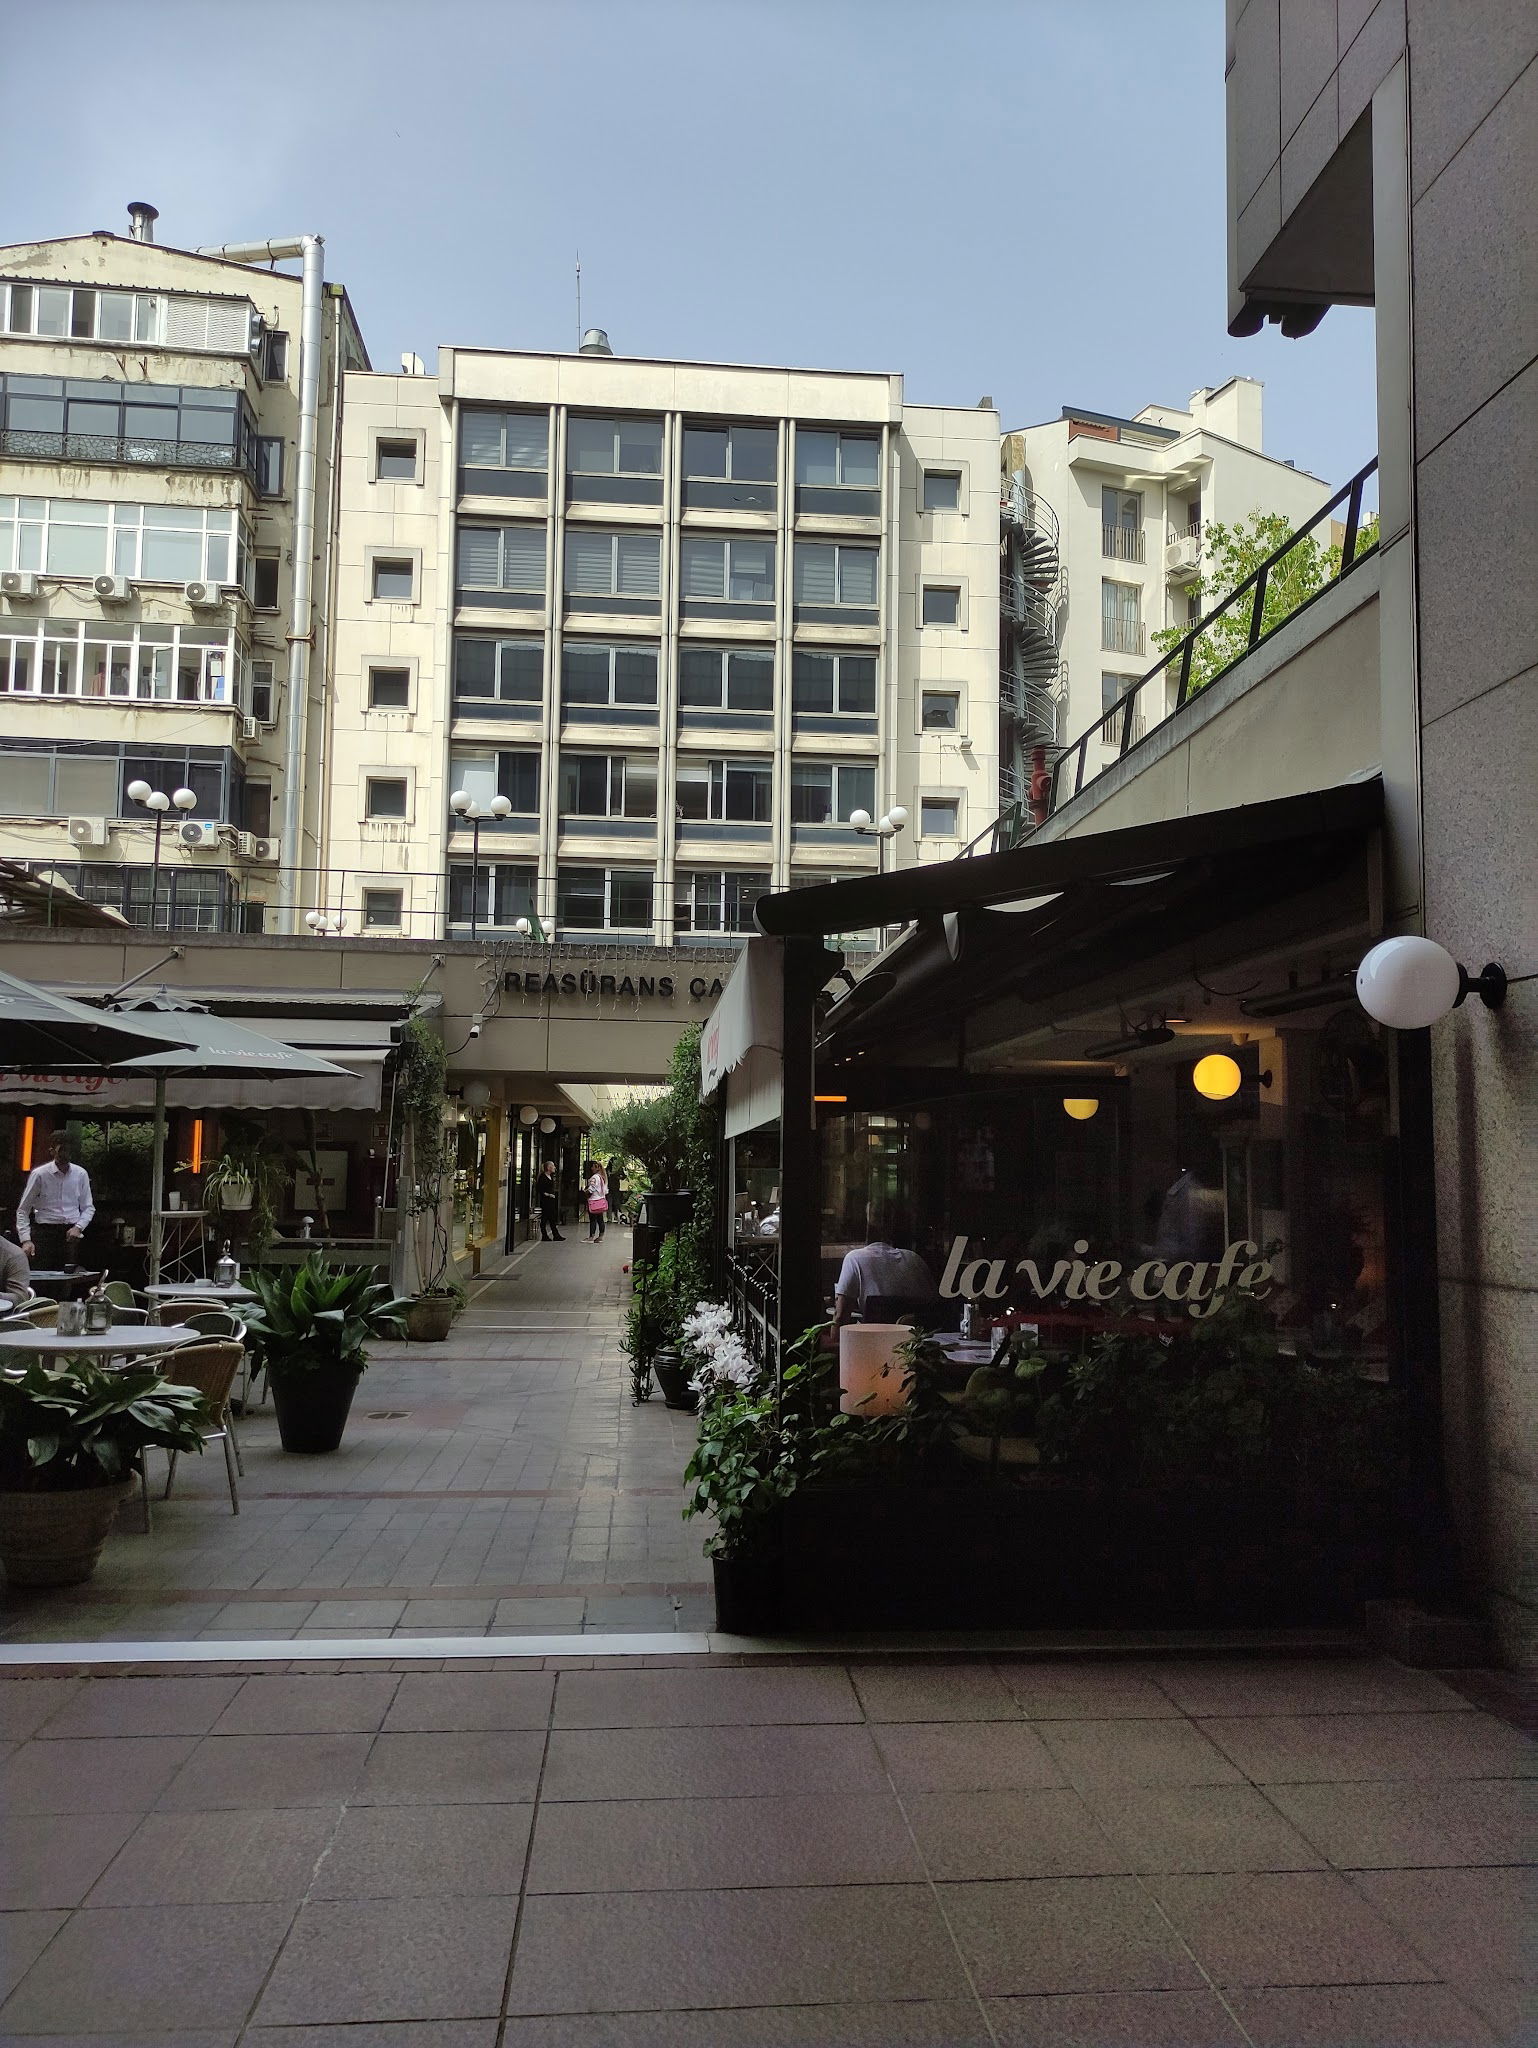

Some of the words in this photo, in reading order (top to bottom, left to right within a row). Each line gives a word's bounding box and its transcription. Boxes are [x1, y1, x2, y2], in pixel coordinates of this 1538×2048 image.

[504, 968, 674, 998] REASÜRANS
[938, 1236, 1009, 1300] la
[1016, 1239, 1123, 1301] vie
